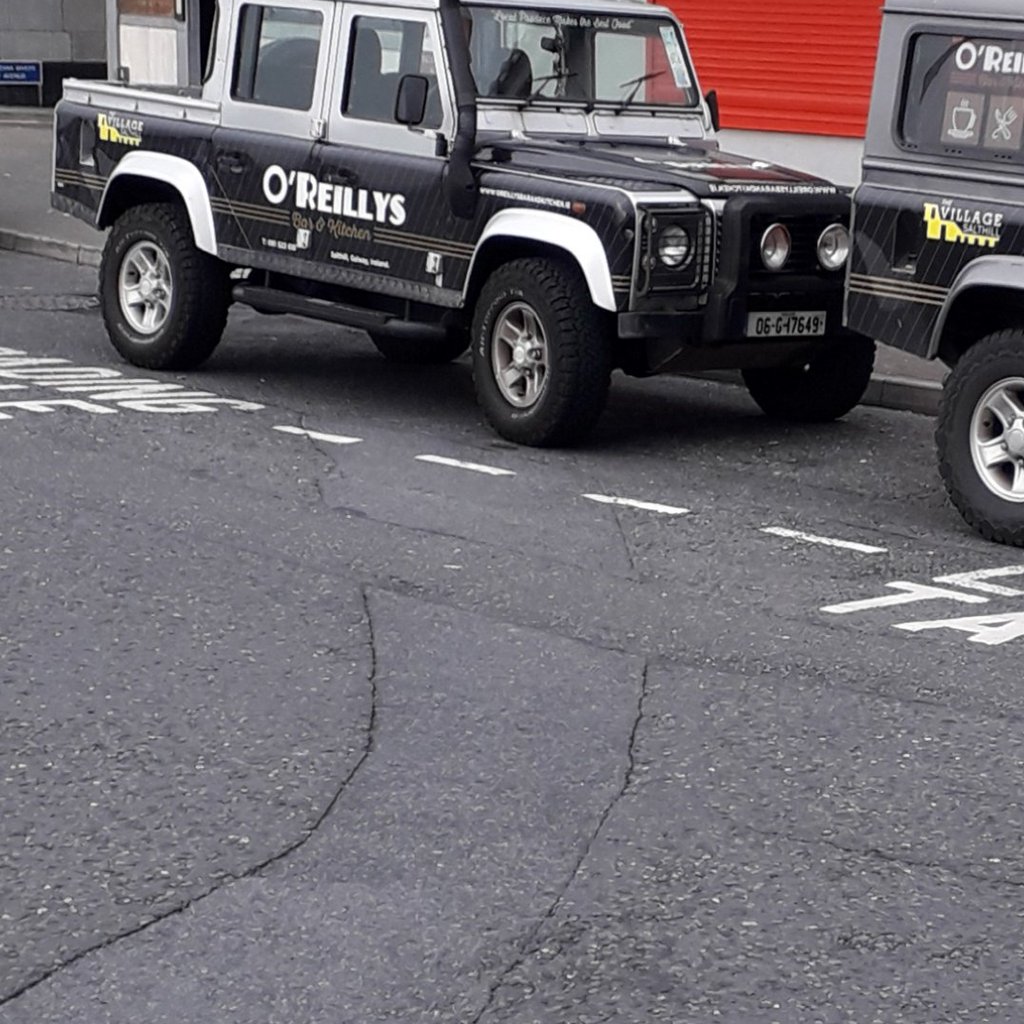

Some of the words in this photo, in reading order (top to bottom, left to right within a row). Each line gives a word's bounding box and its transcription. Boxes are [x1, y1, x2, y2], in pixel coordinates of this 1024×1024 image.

[262, 164, 407, 226] O'REILLYS
[941, 205, 1004, 227] VILLAGE
[327, 218, 372, 241] Kitchen
[962, 223, 1001, 237] SALTHILL
